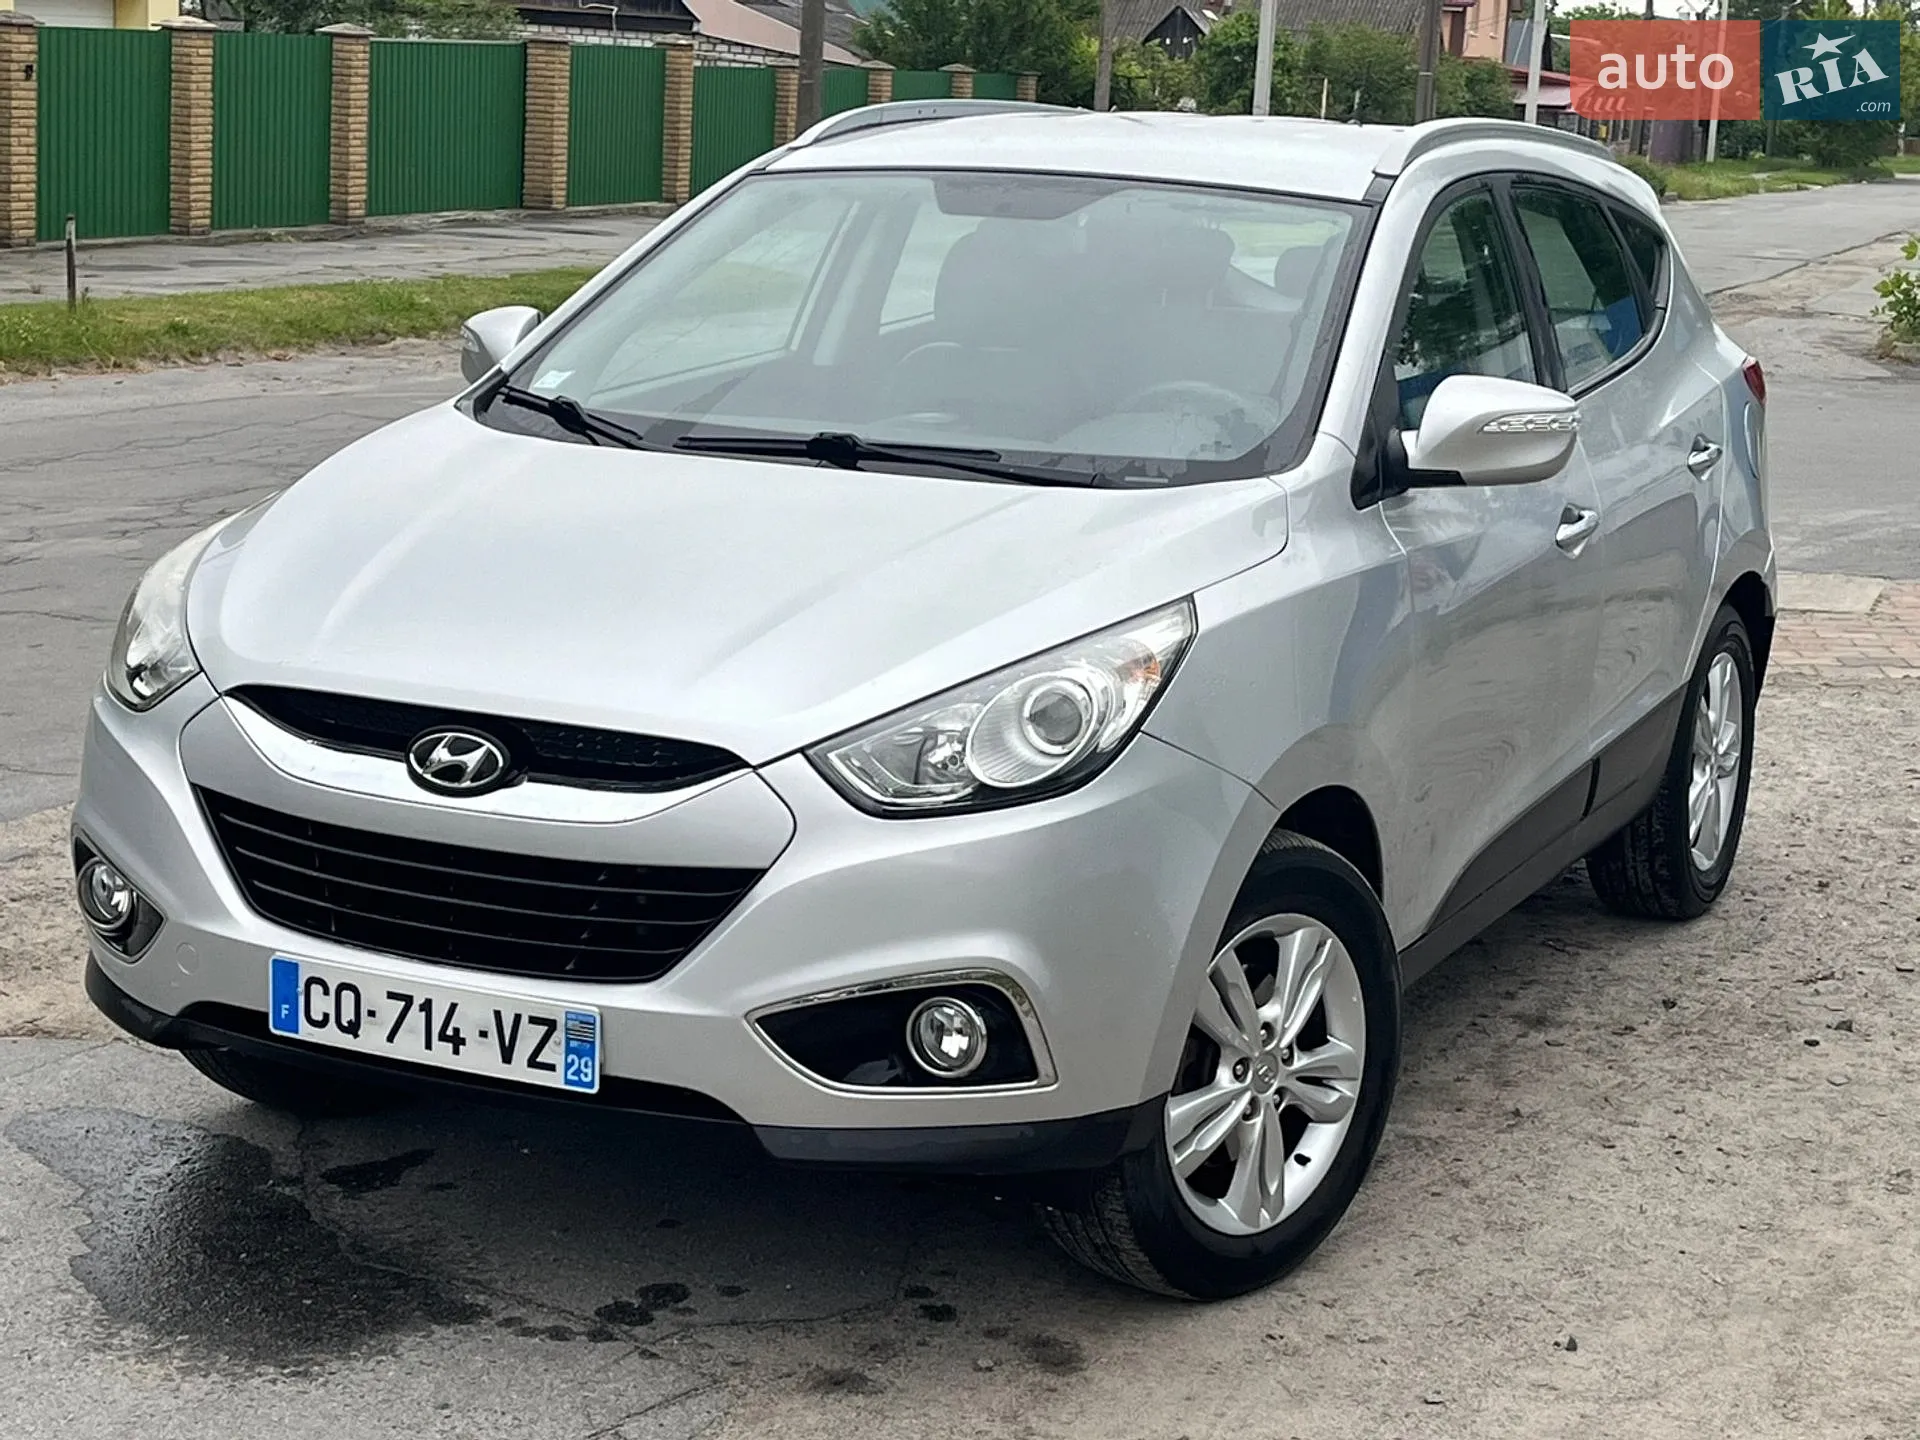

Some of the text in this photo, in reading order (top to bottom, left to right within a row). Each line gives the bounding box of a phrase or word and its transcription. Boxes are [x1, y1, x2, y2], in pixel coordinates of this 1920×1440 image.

[280, 1004, 289, 1019] F
[303, 976, 557, 1072] CQ-714-VZ
[566, 1053, 592, 1083] 29
